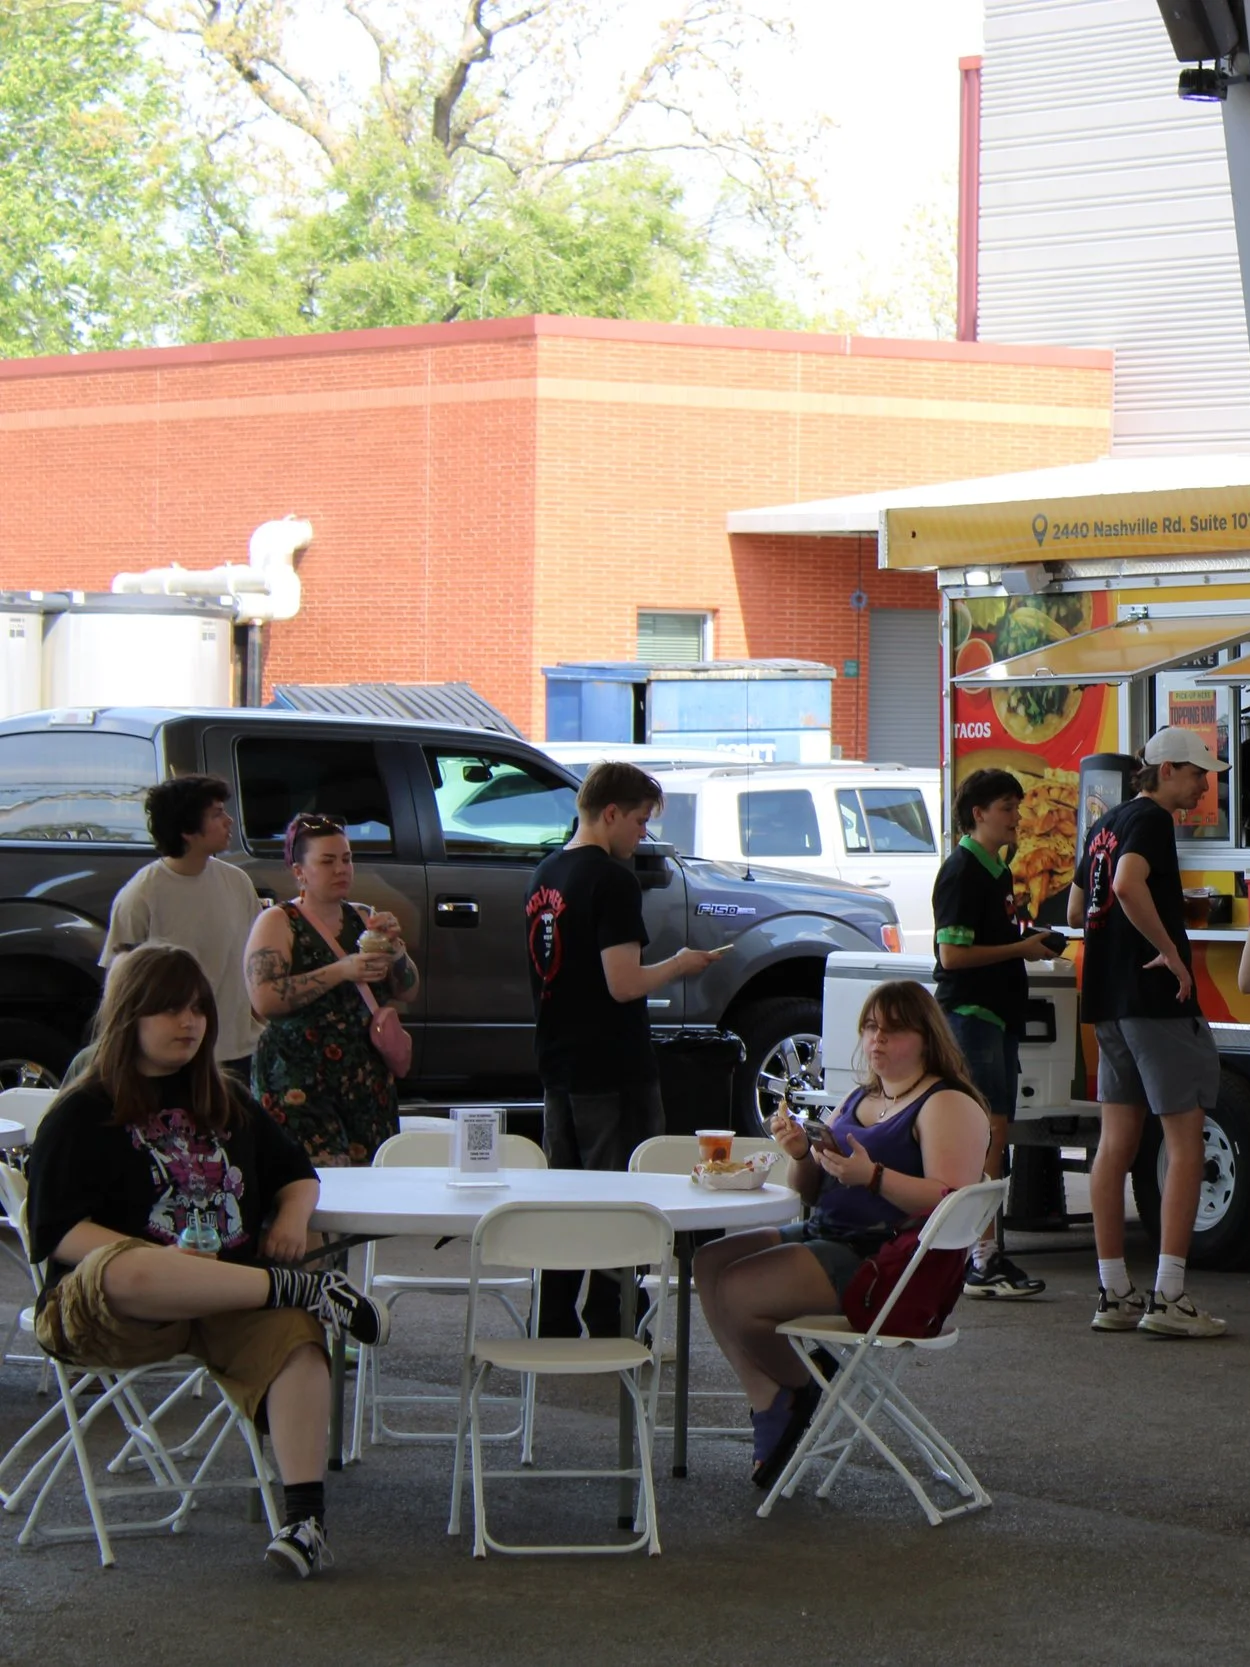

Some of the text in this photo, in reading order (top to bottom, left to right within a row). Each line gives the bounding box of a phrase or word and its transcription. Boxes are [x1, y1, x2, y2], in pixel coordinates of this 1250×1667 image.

[1053, 522, 1089, 541] 2440
[1094, 518, 1158, 538] Nashville
[1162, 517, 1186, 534] Rd.
[1190, 514, 1228, 532] Suite
[954, 721, 991, 739] TACOS
[698, 904, 738, 916] F-150
